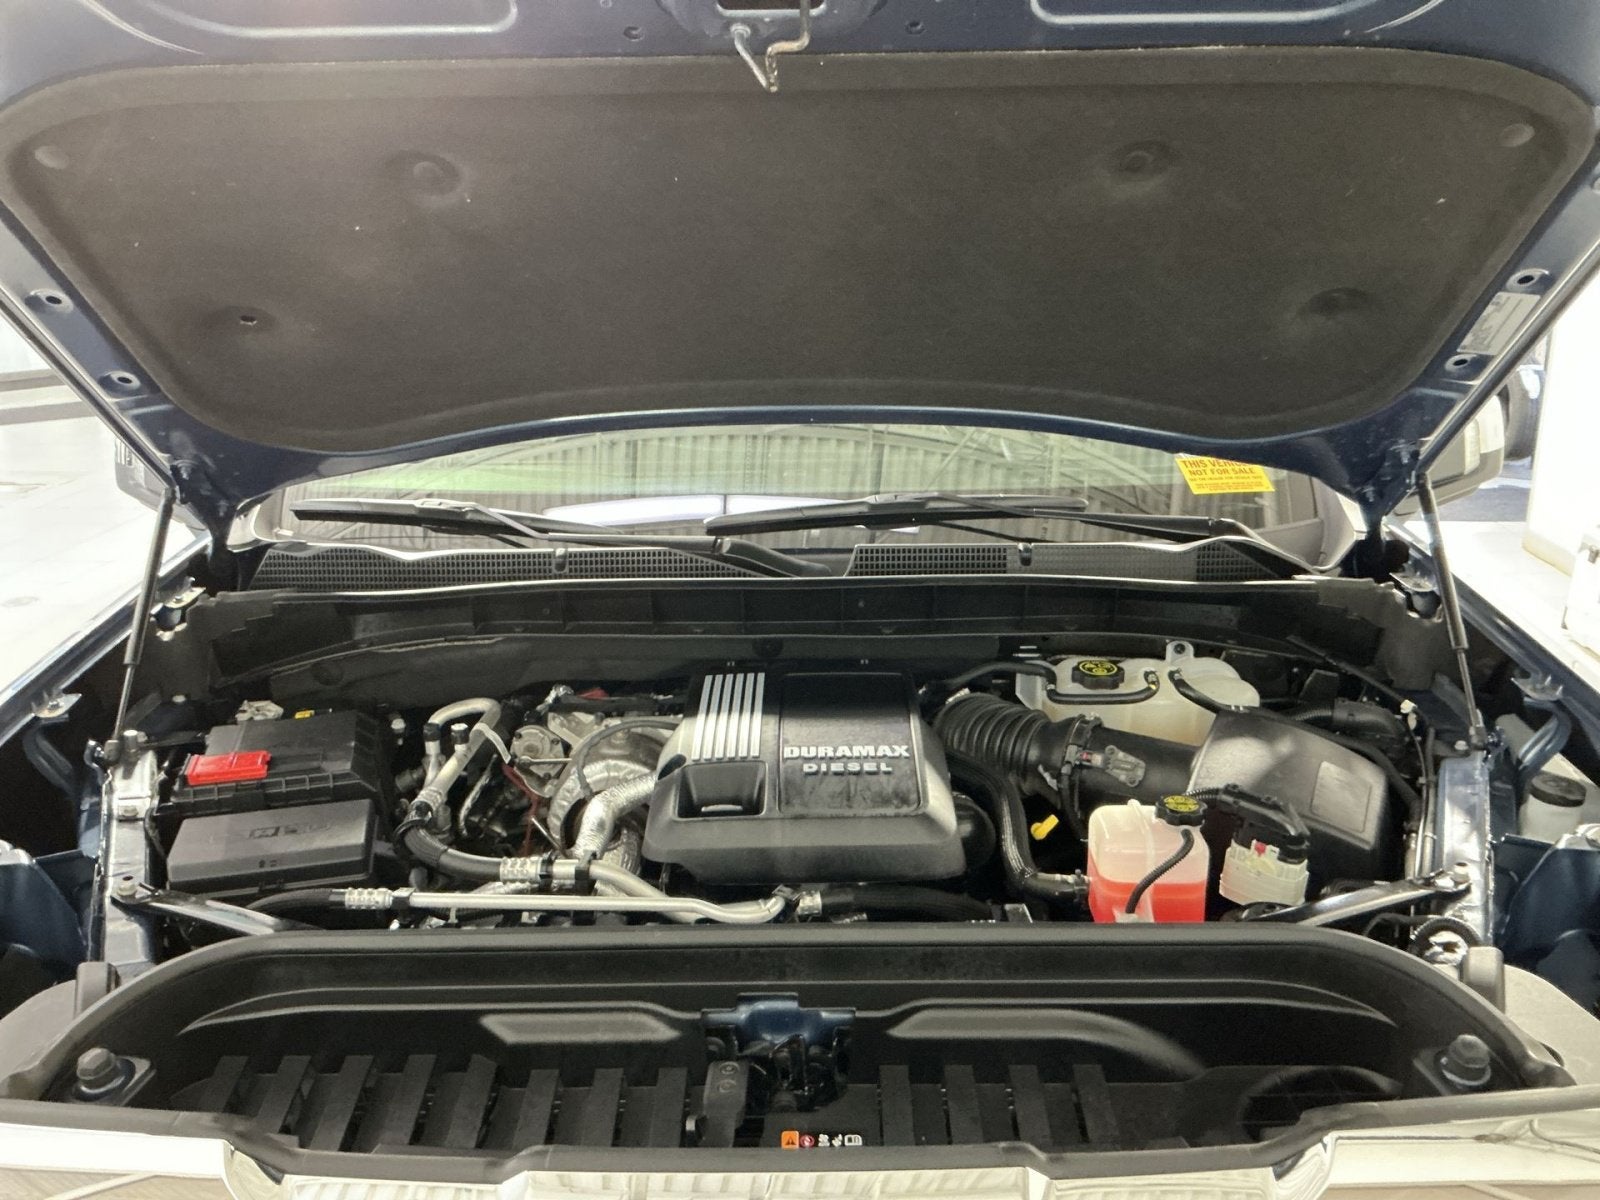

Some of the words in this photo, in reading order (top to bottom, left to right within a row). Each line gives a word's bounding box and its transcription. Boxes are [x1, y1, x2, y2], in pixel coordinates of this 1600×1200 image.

[1181, 460, 1208, 468] THIS
[1208, 459, 1250, 468] VEHI
[1232, 467, 1256, 475] SALE
[783, 745, 910, 759] DURAMAX
[803, 762, 893, 774] DIESEL
